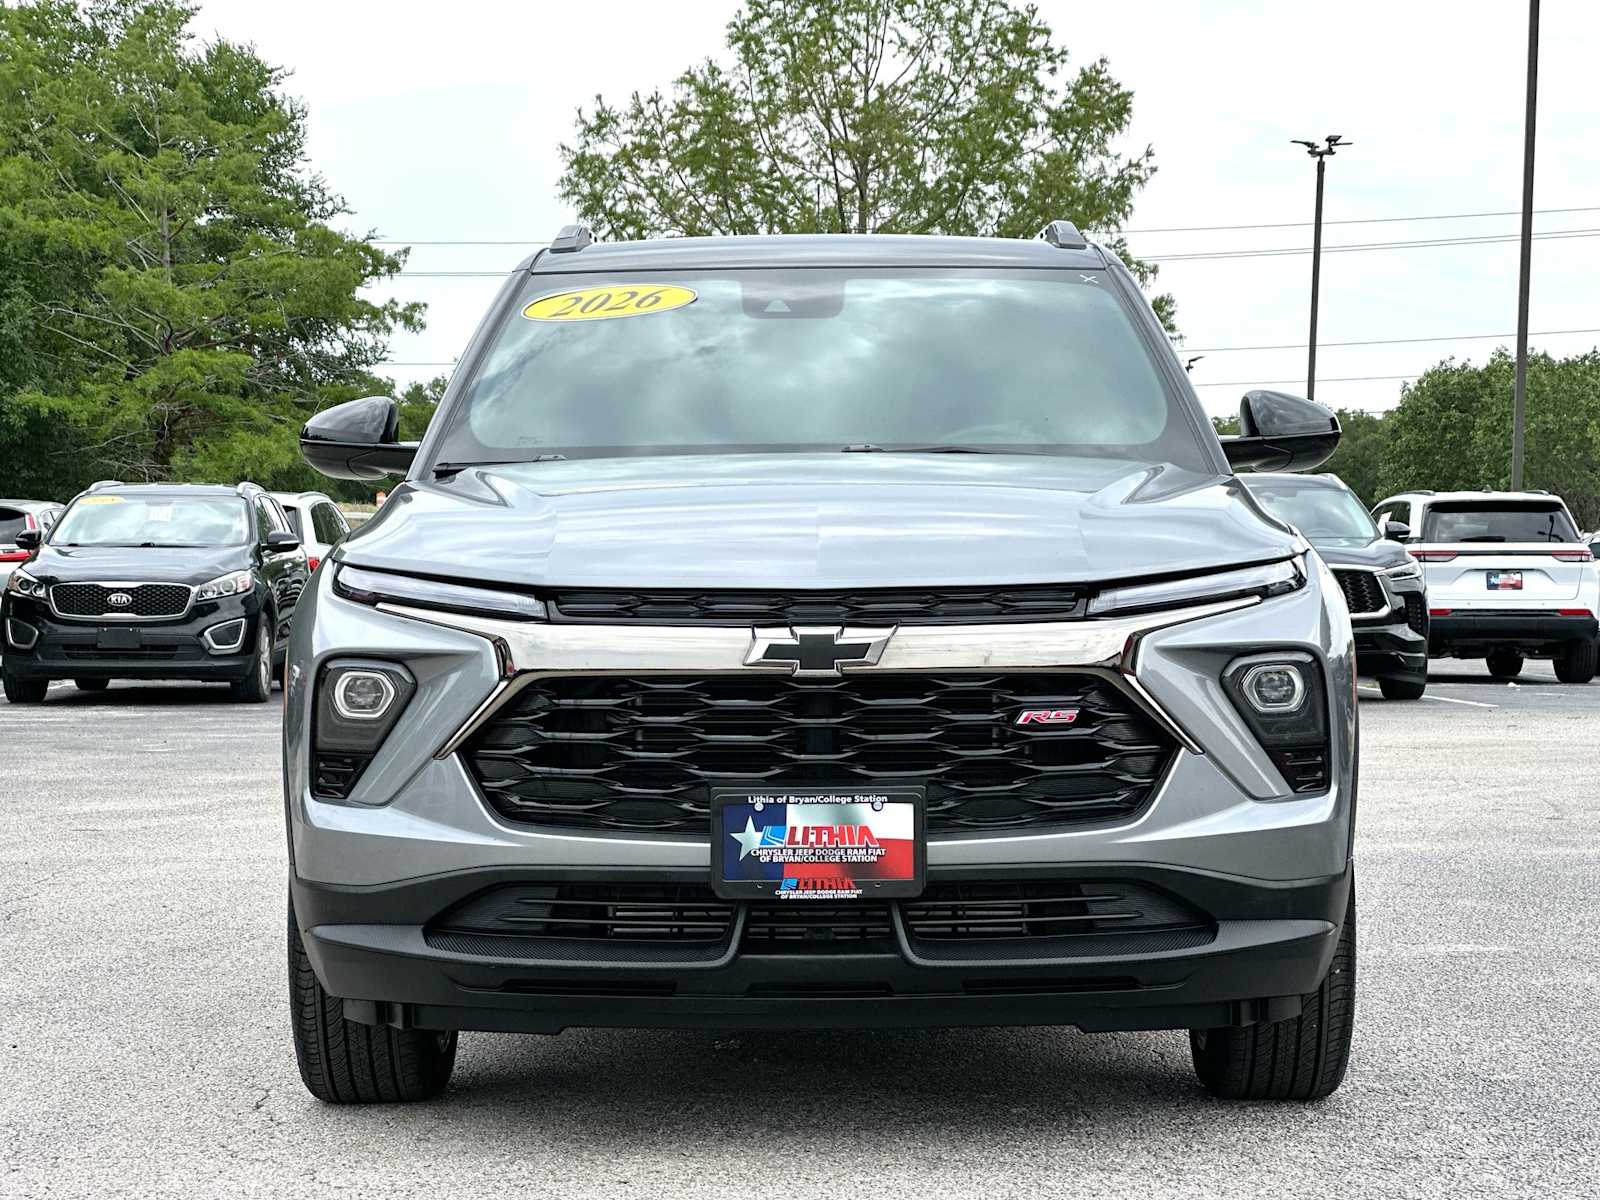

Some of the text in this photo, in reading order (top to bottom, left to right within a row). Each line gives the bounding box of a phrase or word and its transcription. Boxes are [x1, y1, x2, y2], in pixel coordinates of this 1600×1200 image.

[548, 288, 671, 317] 2026
[1016, 709, 1079, 724] RS
[747, 794, 888, 805] Lithia of Bryan/College Station
[787, 826, 880, 847] LITHIA
[751, 848, 886, 856] CHRYSLER JEEP DODGE RAM FIAT
[760, 855, 877, 863] OF BRYAN/COLLEGE STATION
